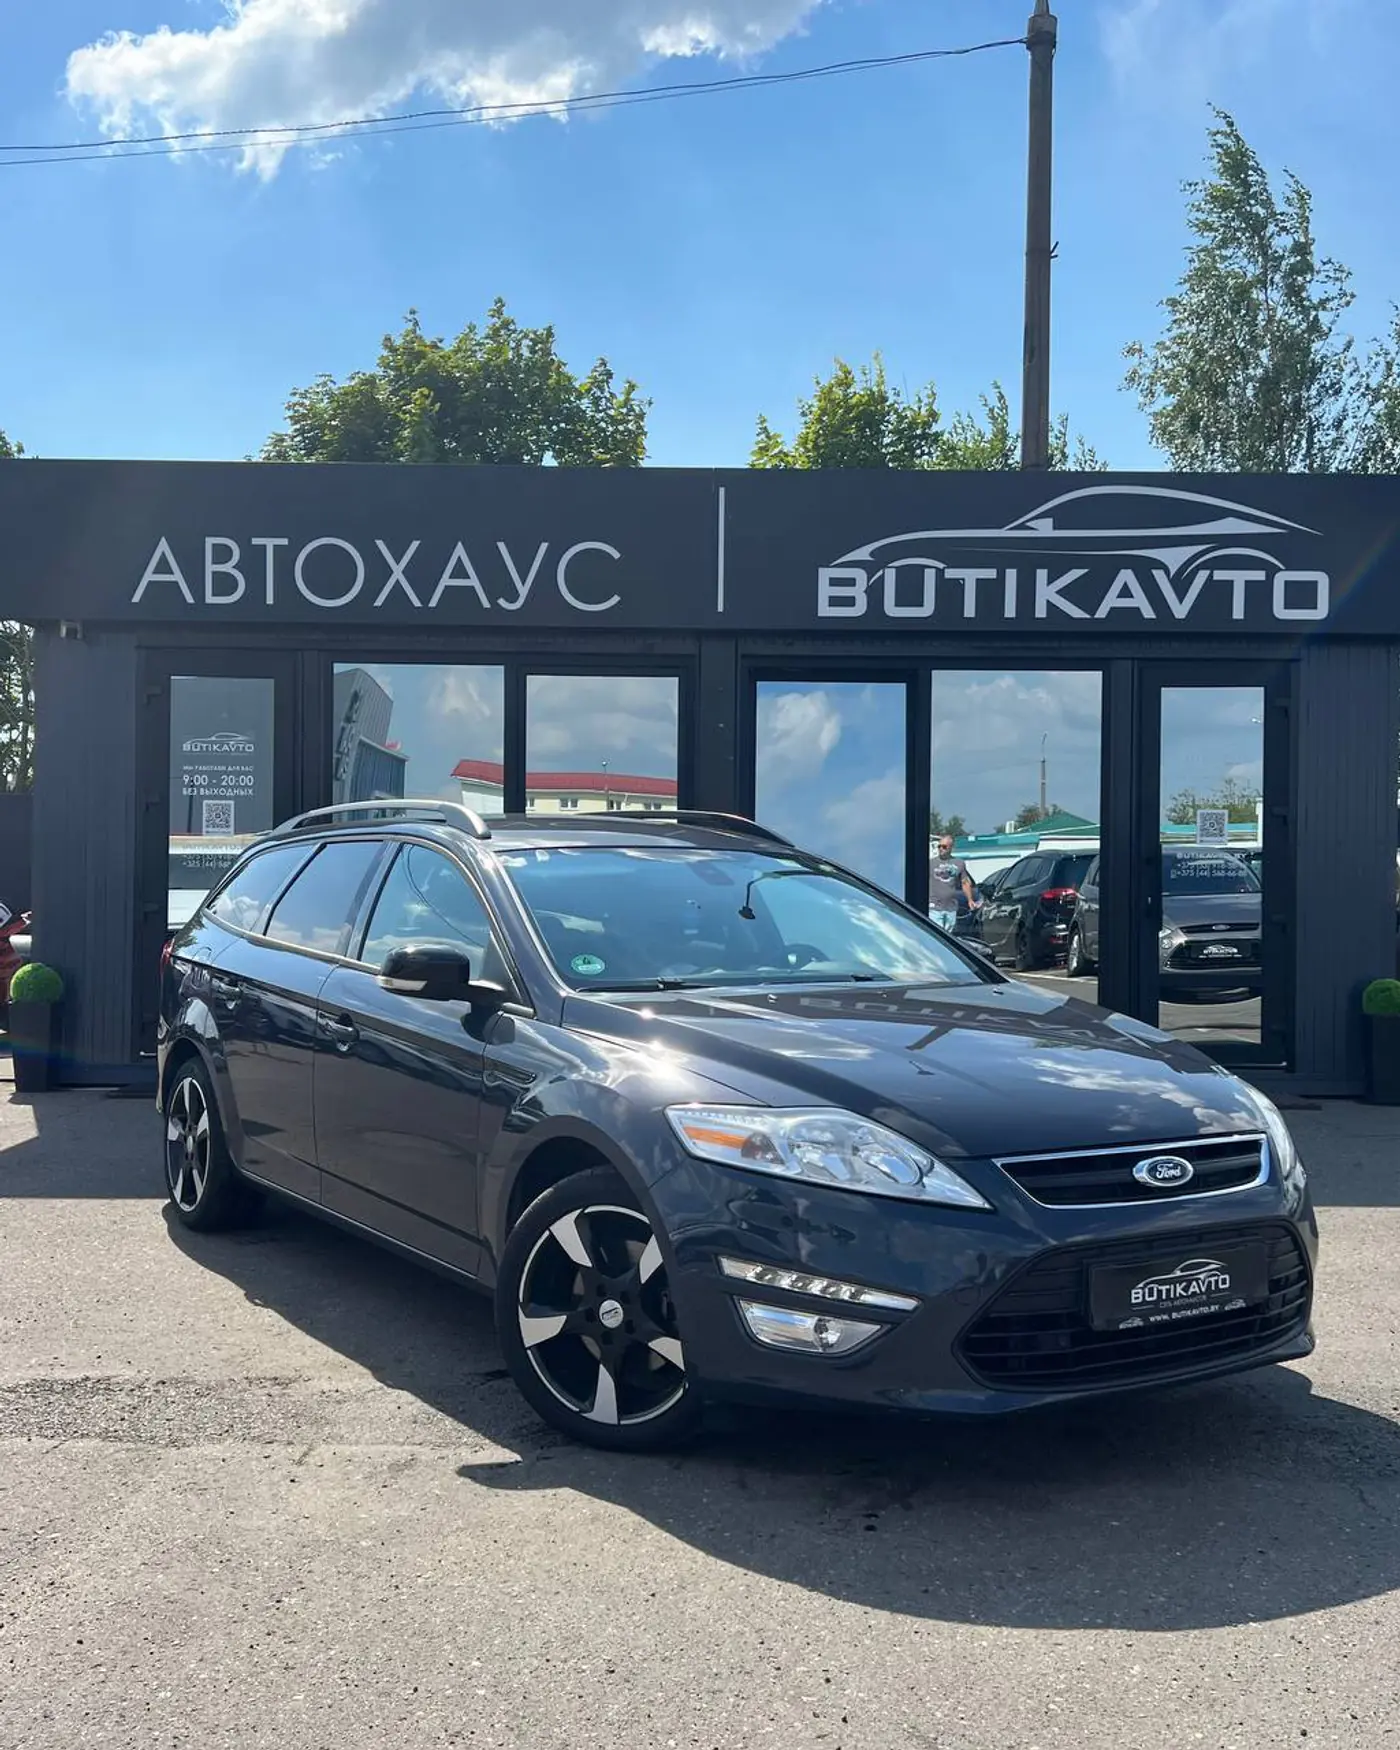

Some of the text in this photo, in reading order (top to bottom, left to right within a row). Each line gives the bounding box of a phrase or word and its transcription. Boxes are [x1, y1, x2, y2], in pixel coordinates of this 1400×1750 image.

[131, 535, 622, 612] АВТОХАУС
[817, 567, 1330, 620] BUTIKAVTO
[182, 743, 255, 752] BUTIKAVTO
[182, 774, 208, 786] 9:00
[221, 774, 254, 787] 20:00
[182, 787, 254, 797] БЕЗ ВЫХОДНЫХ
[1156, 1163, 1182, 1179] Ford
[1130, 1274, 1231, 1304] BUTIKAVTO
